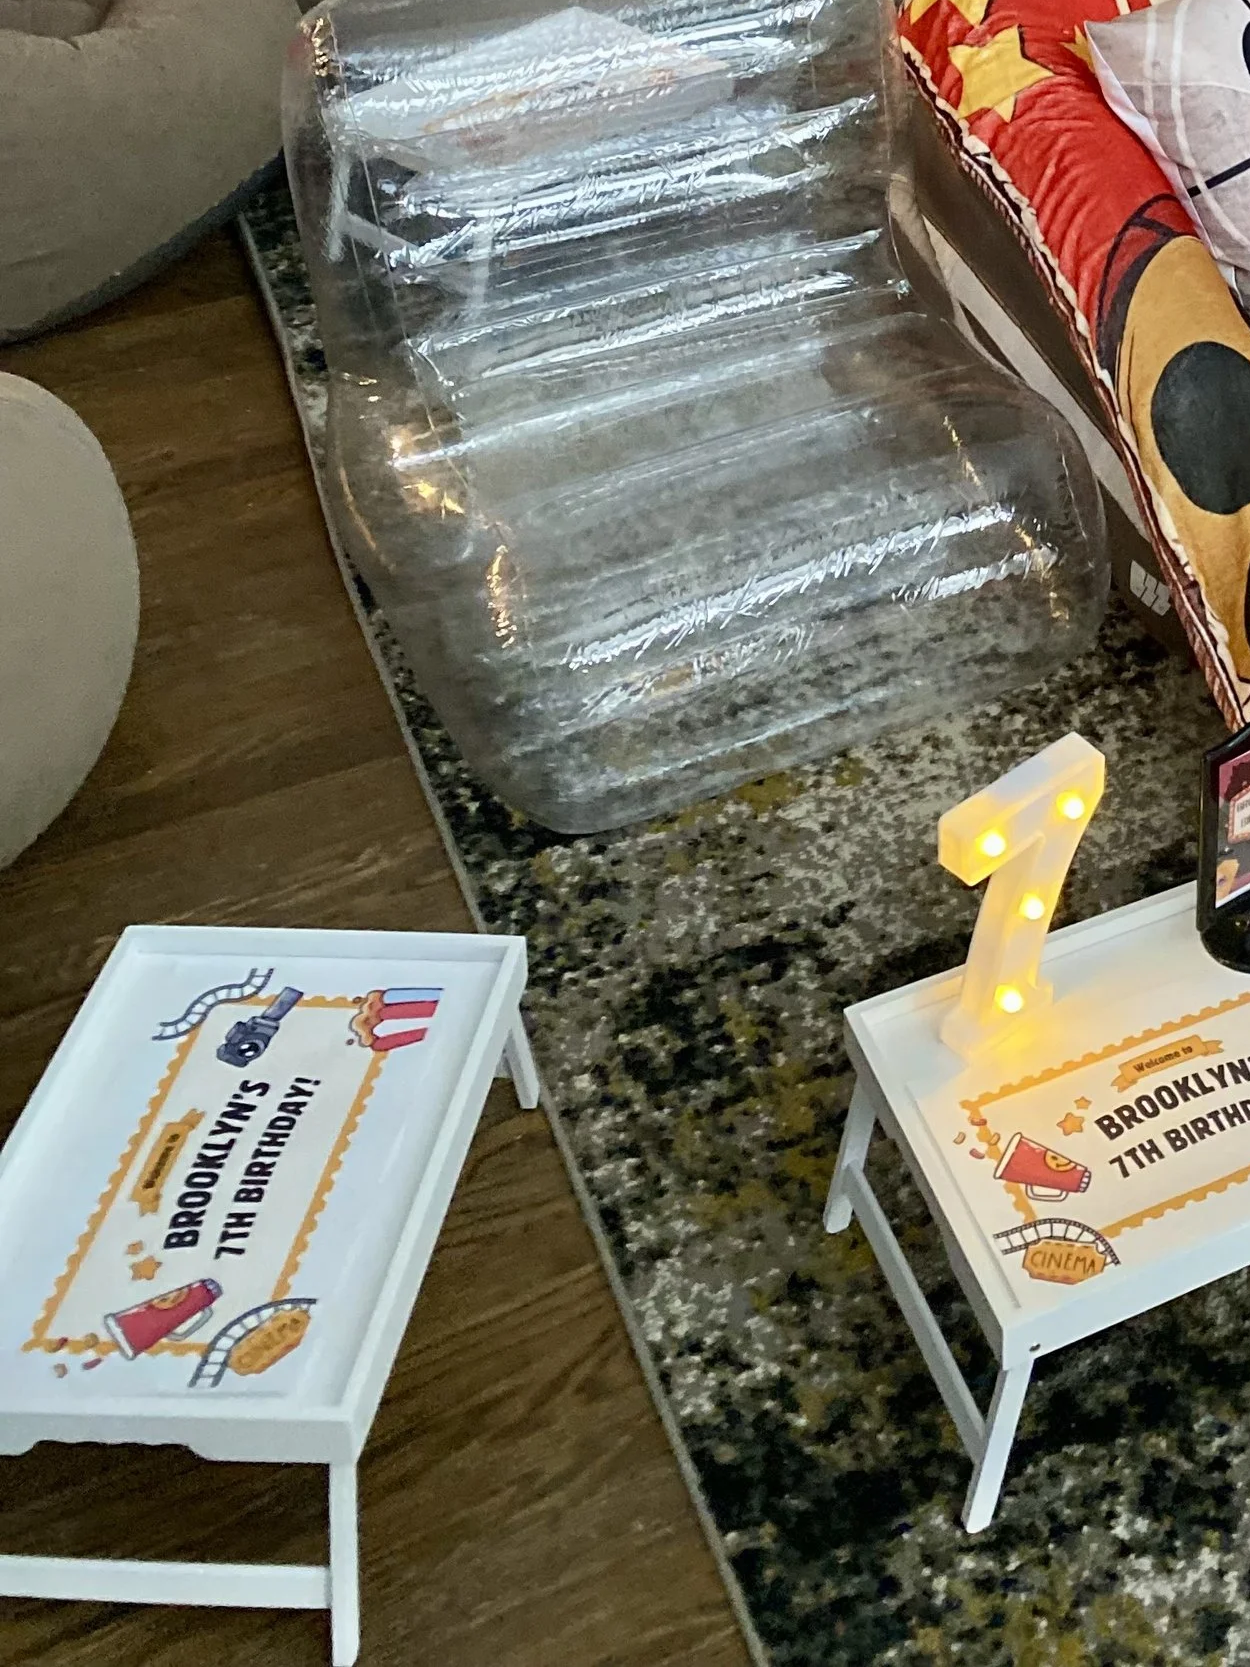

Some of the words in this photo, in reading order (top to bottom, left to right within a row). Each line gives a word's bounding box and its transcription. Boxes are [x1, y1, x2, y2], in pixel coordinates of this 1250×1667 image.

[1132, 1051, 1181, 1072] Welcome
[1181, 1045, 1194, 1054] to
[235, 1076, 322, 1204] BIRTHDAY!
[1109, 1134, 1165, 1180] 7TH
[163, 1078, 271, 1251] BROOKLYN'S
[213, 1210, 258, 1260] 7TH
[1030, 1250, 1097, 1274] CINEMA
